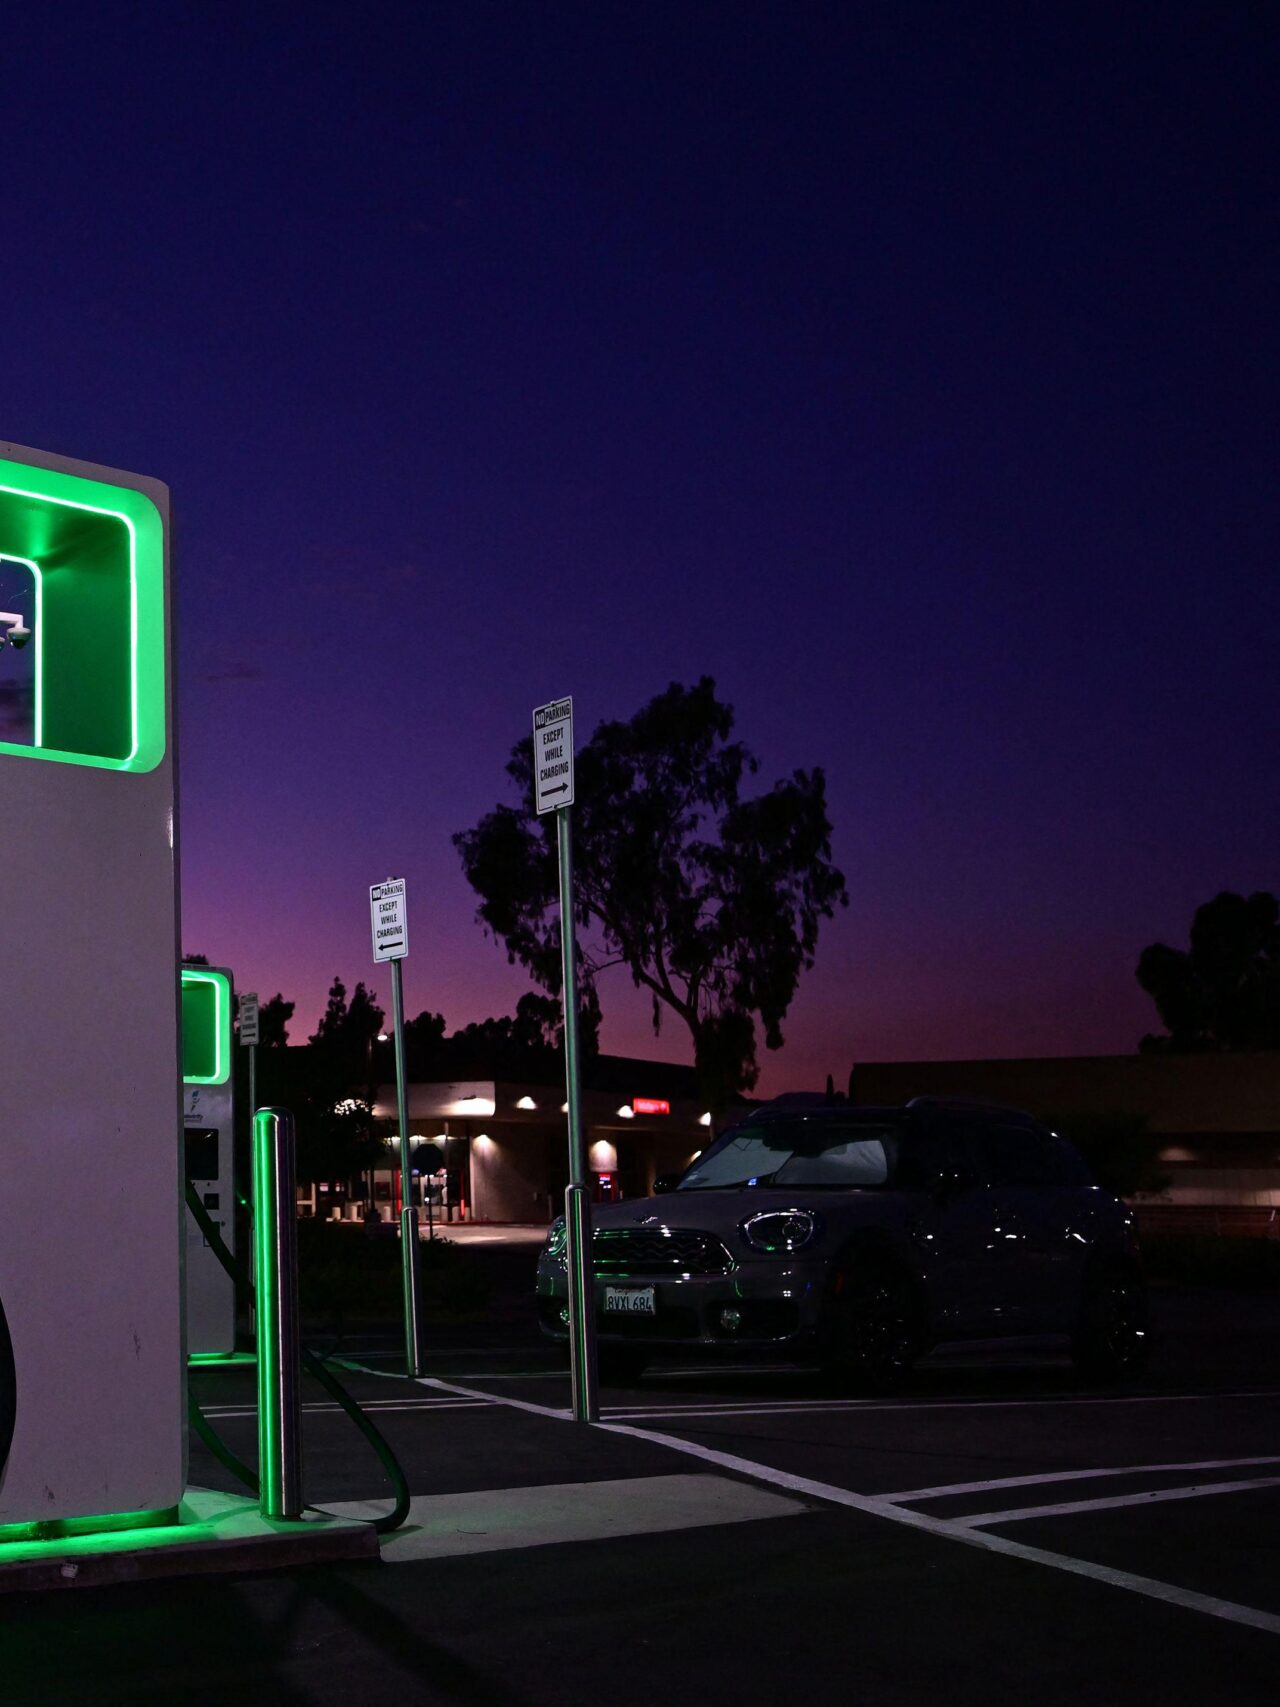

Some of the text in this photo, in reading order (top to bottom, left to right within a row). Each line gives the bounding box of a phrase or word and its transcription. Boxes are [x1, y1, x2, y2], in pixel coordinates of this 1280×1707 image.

[535, 703, 570, 727] NO PARKING
[543, 727, 564, 745] EXCEPT
[545, 745, 563, 762] WHILE
[540, 761, 569, 781] CHARGING
[381, 884, 403, 897] PARKING
[379, 900, 398, 913] EXCEPT
[380, 913, 397, 925] WHILE
[377, 925, 403, 939] CHARGING
